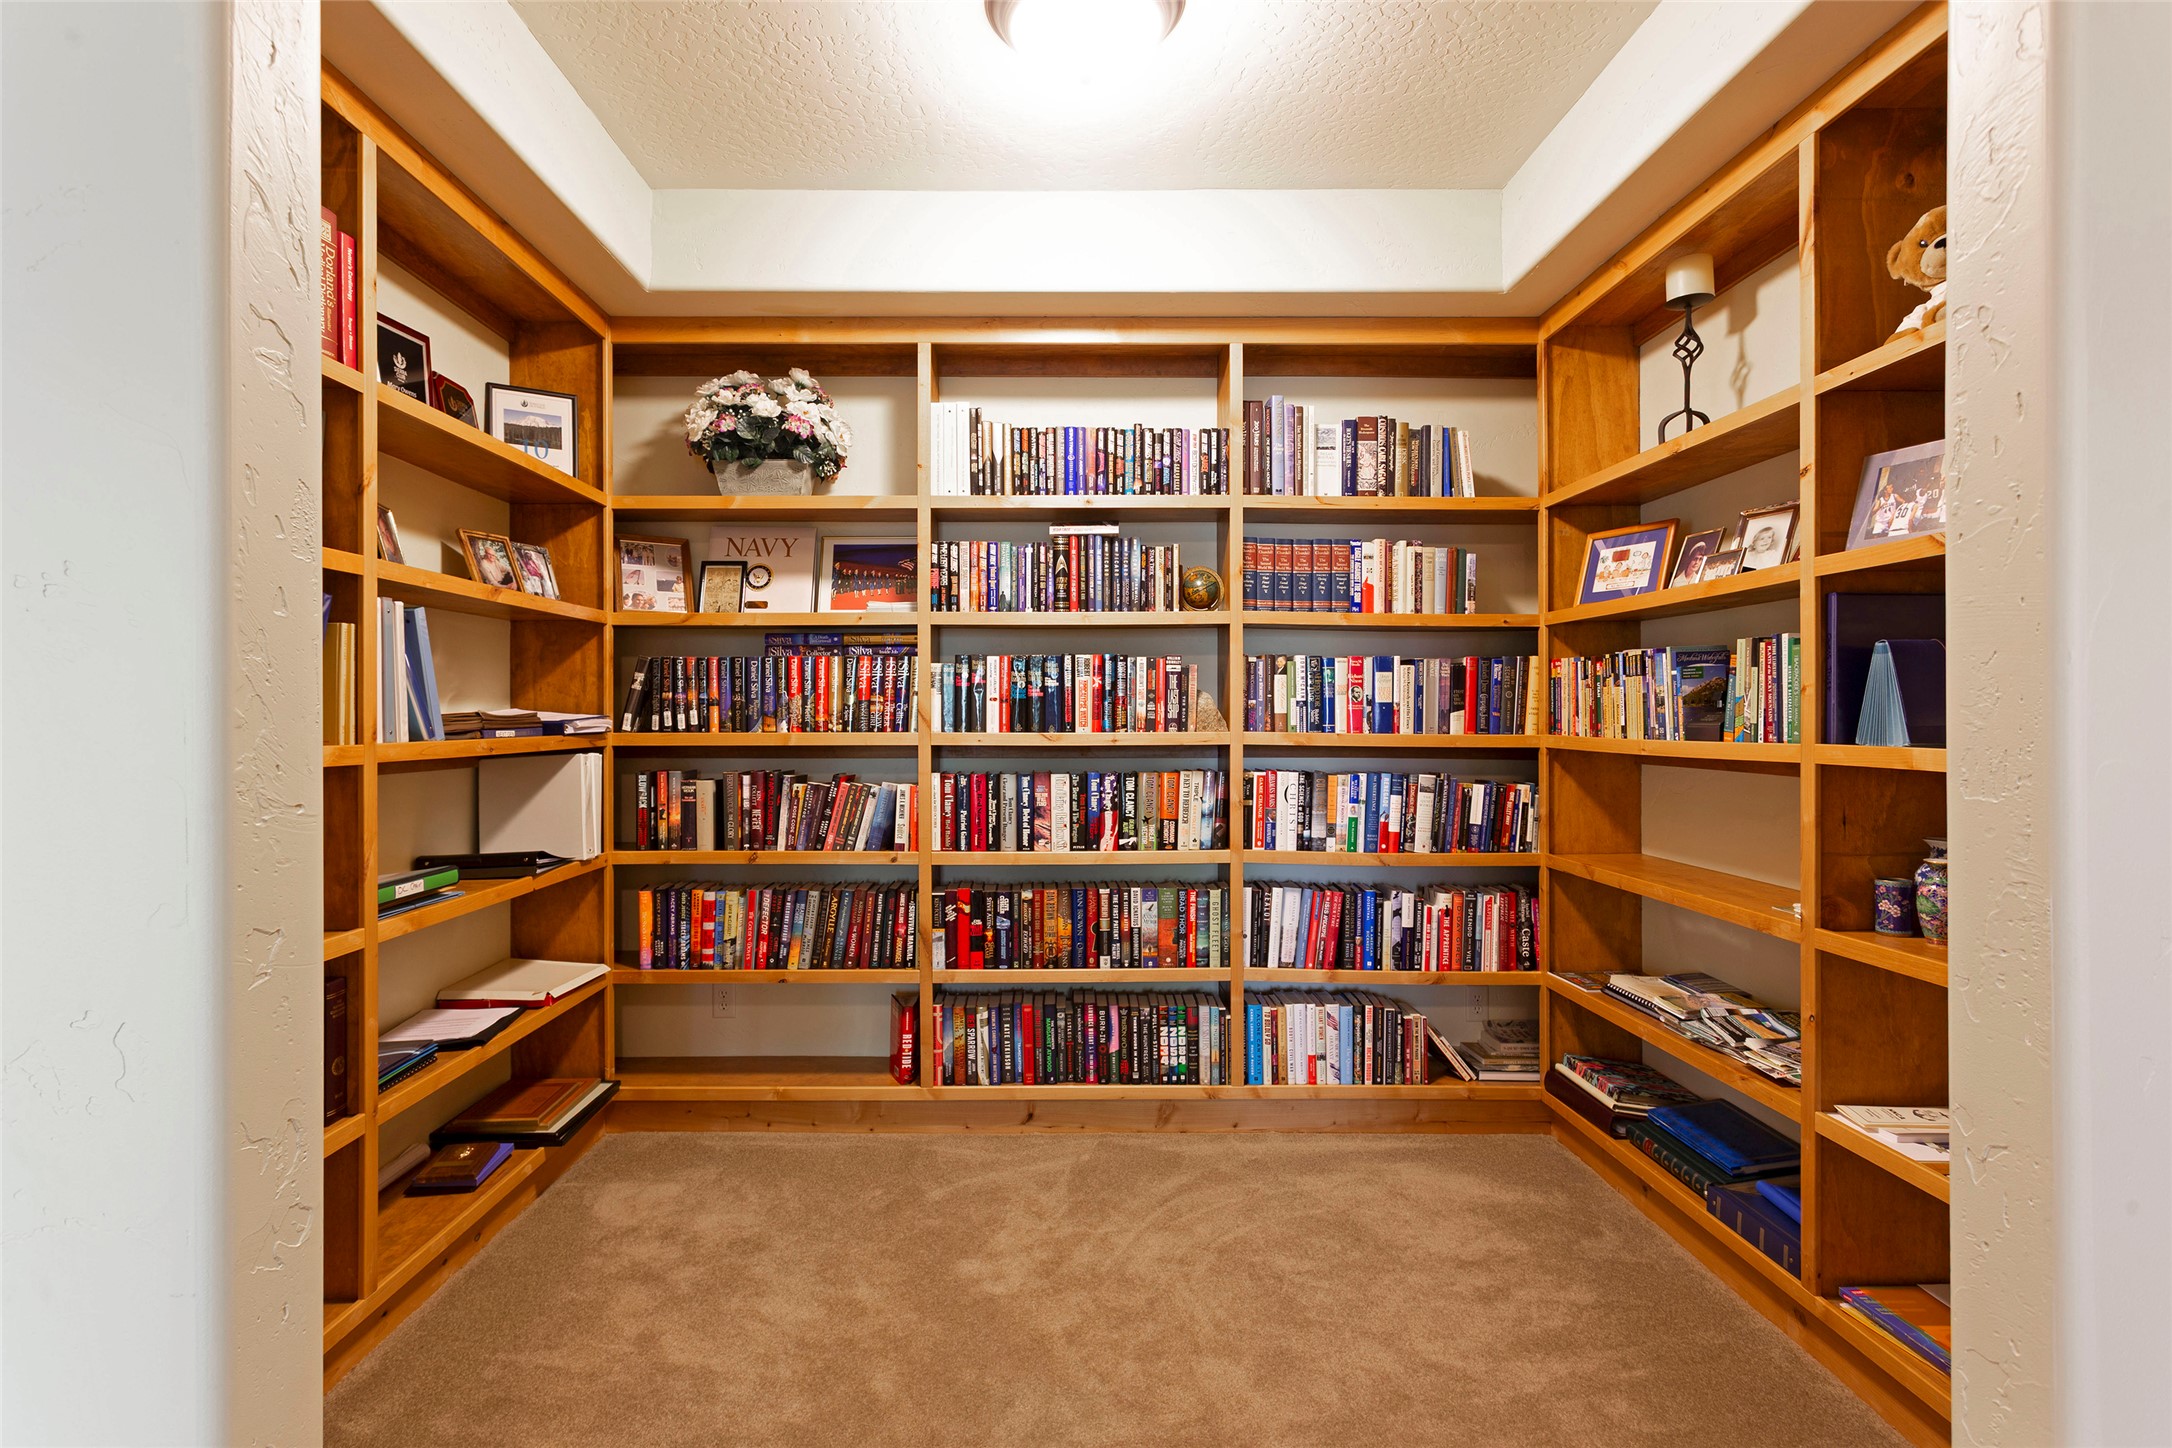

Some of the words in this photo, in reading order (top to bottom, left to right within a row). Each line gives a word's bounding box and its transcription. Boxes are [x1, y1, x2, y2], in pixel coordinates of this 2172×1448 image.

[325, 246, 337, 308] Dorland's
[523, 438, 549, 460] 10
[1378, 447, 1386, 462] CARL
[724, 537, 799, 557] NAVY
[770, 646, 793, 656] Silva
[850, 646, 873, 655] Silva
[898, 663, 908, 688] Silva
[639, 775, 647, 808] BLOWBACK
[1126, 777, 1134, 790] TOM
[1167, 777, 1175, 790] TOM
[944, 795, 953, 817] Clancy
[1021, 789, 1030, 806] Clancy
[1126, 793, 1134, 817] CLANCY
[1167, 792, 1175, 814] CLANCY
[752, 809, 761, 830] NEVER
[761, 898, 769, 934] DEFECTOR
[827, 896, 837, 933] ARGYLLE
[849, 933, 857, 957] WOMEN
[1522, 928, 1530, 957] Caste
[902, 1034, 912, 1048] RED
[968, 1028, 976, 1059] SPARROW
[902, 1052, 911, 1068] TIDE
